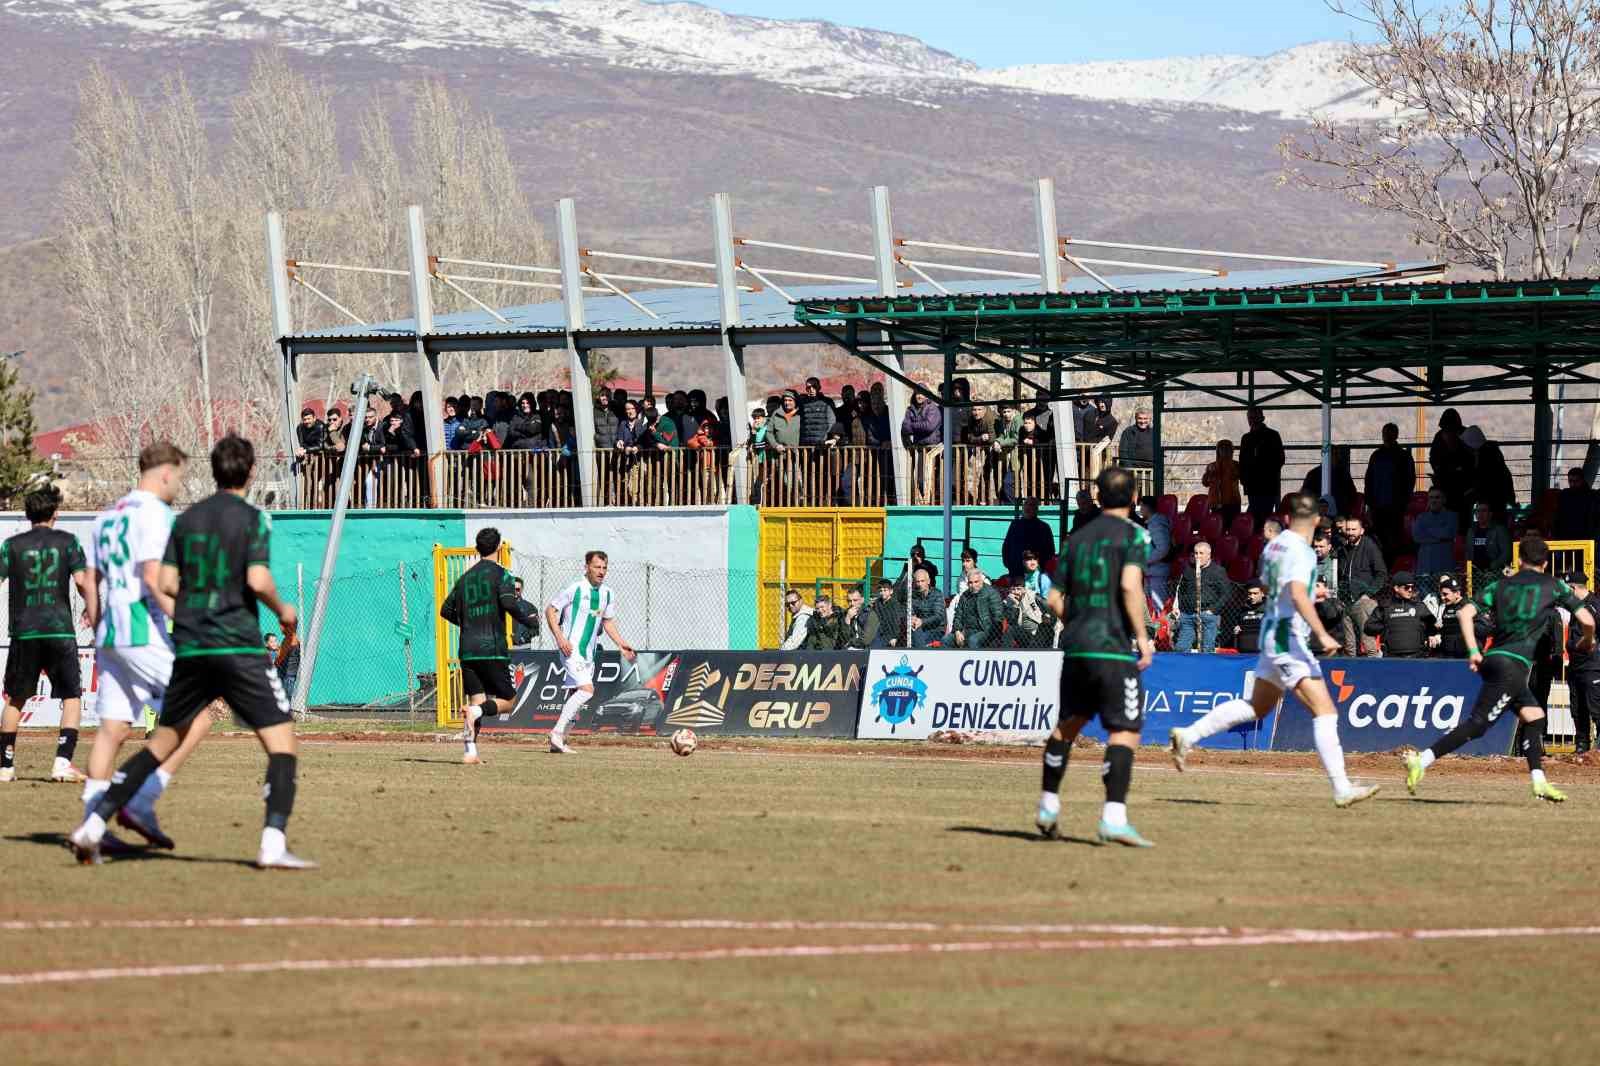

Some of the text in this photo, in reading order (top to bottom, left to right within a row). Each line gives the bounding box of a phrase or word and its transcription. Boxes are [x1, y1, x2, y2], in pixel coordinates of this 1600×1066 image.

[21, 547, 60, 590] 32
[183, 532, 230, 589] 54
[545, 662, 642, 682] MDA
[959, 659, 1037, 686] CUNDA
[748, 702, 831, 729] GRUP
[931, 696, 1053, 730] DENİZCİLİK
[1348, 687, 1465, 729] cata
